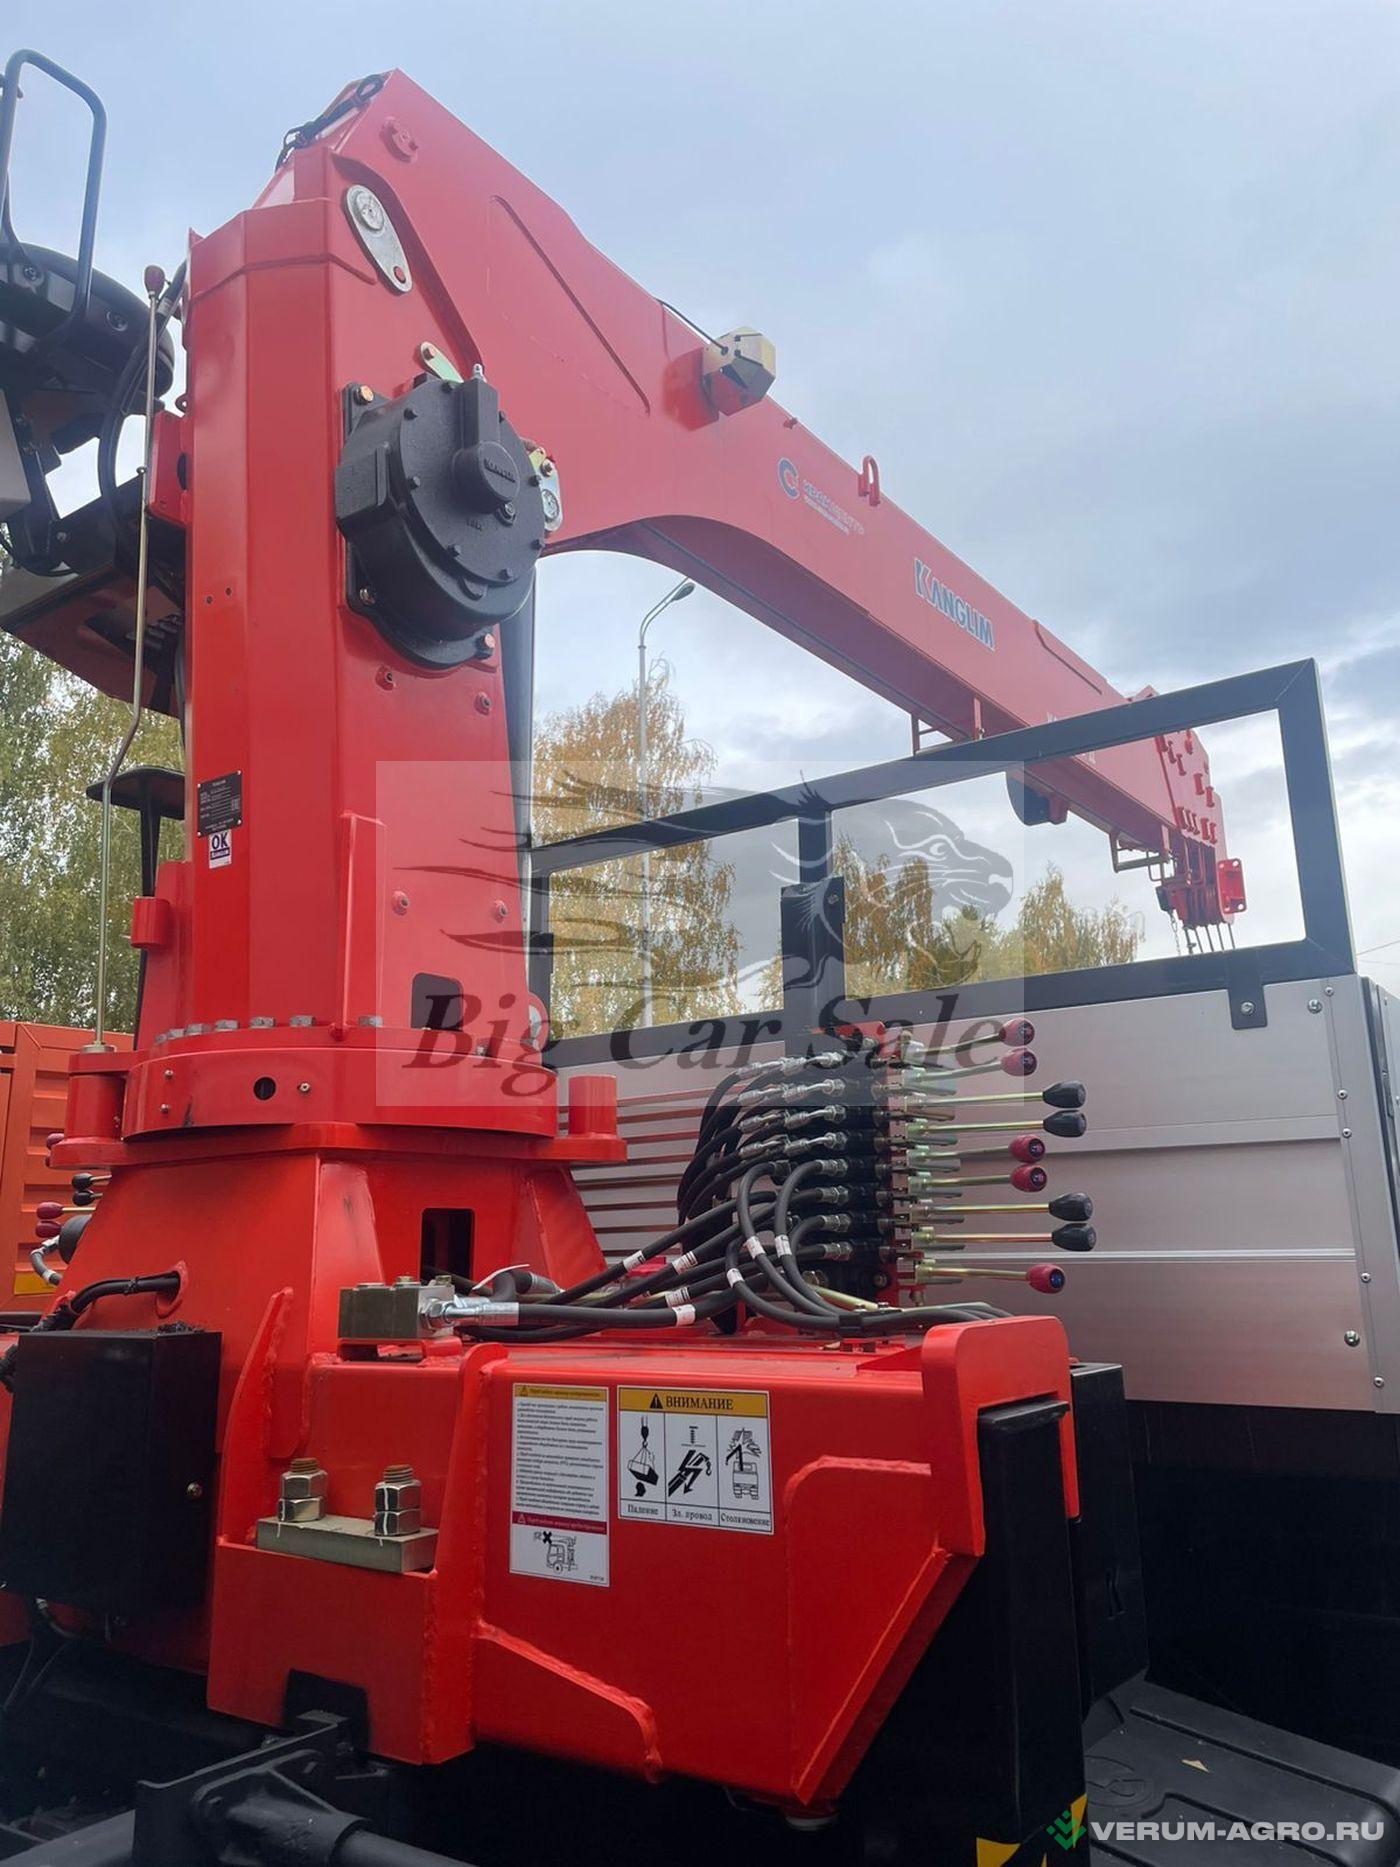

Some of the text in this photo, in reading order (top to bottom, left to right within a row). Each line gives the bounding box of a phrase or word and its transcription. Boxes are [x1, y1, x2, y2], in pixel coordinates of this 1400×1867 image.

[913, 557, 995, 652] KANGLIM
[212, 832, 228, 849] OK
[666, 1395, 734, 1410] ВНИМАНИЕ
